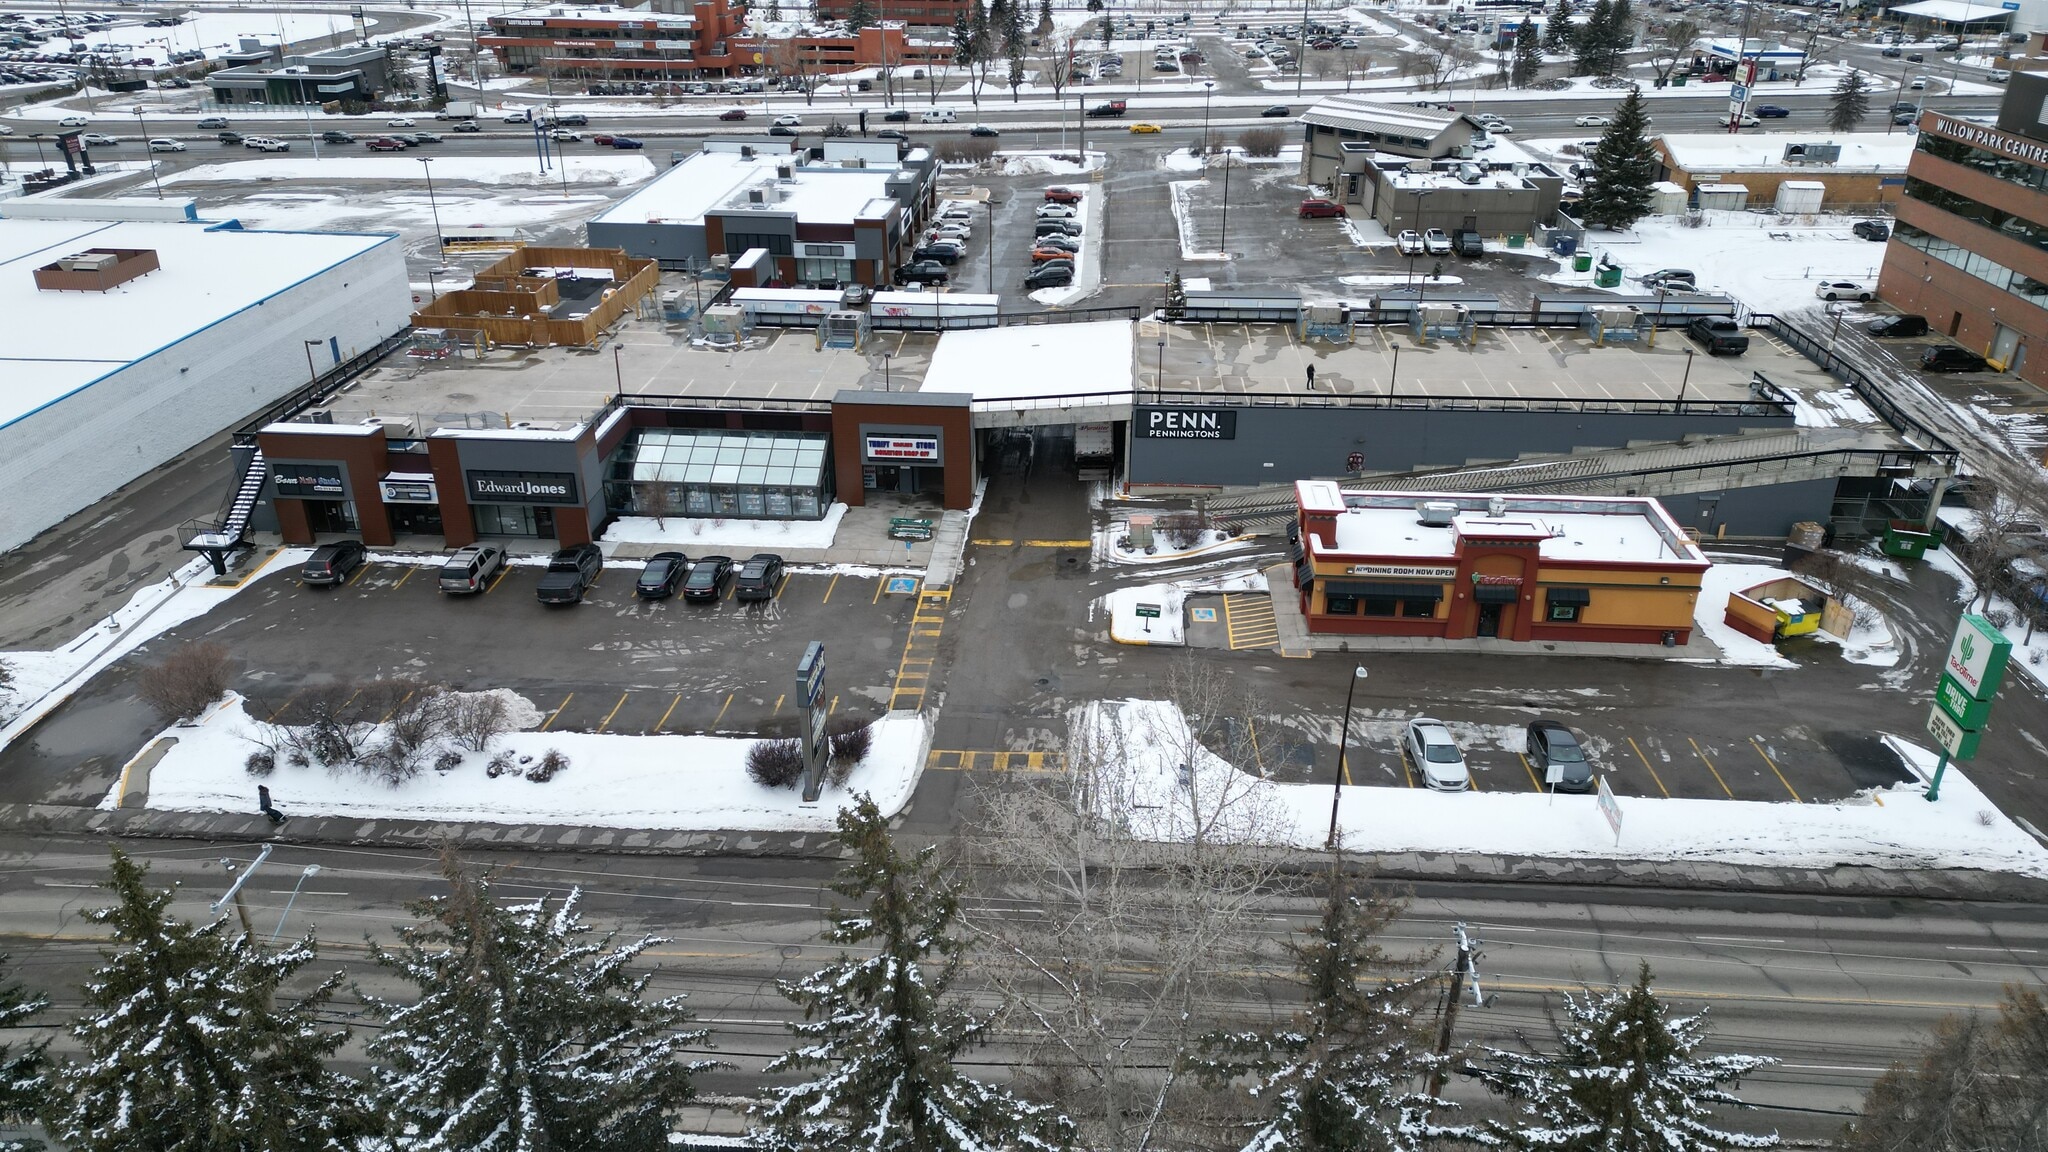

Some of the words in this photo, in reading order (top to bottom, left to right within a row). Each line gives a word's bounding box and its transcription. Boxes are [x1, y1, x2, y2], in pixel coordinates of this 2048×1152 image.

[1936, 118, 1976, 141] WILLOW
[1975, 130, 2005, 150] PARK
[2005, 139, 2048, 164] CENTRE
[1149, 411, 1221, 429] PENN.
[1149, 429, 1220, 439] PENNINGTONS
[868, 440, 890, 449] THRIFT
[915, 441, 936, 450] STORE
[874, 449, 903, 457] DONATION
[477, 480, 526, 493] Edward
[526, 481, 566, 495] Jones
[1367, 567, 1392, 575] DINING
[1393, 567, 1414, 576] ROOM
[1415, 568, 1434, 577] NOW
[1435, 568, 1455, 578] OPEN
[1950, 654, 1978, 687] TacoTime
[1945, 681, 1968, 709] DRIVE
[1949, 698, 1966, 719] THRU
